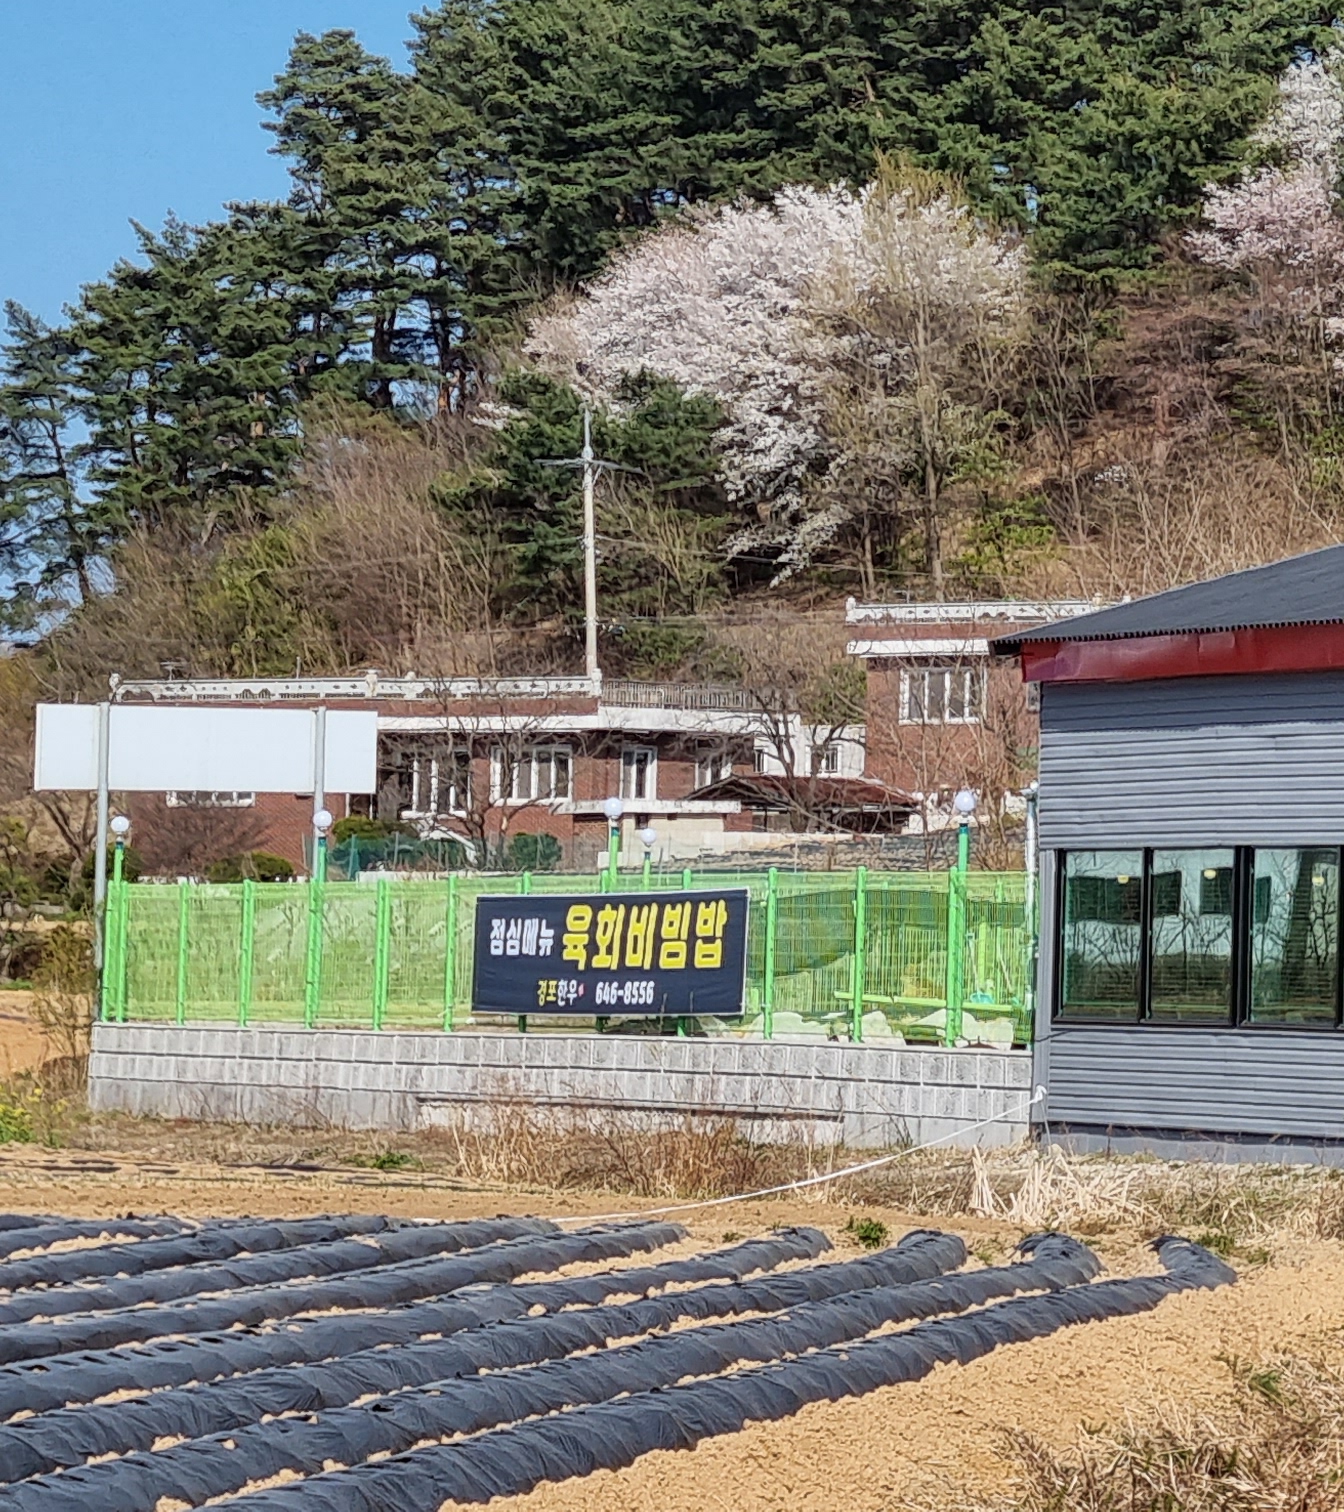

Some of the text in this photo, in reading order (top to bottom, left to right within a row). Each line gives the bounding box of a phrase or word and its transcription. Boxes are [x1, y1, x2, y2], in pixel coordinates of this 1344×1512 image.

[490, 899, 728, 970] 점심메뉴 육회비빔밥
[537, 979, 655, 1006] 경포한우 646-8556
